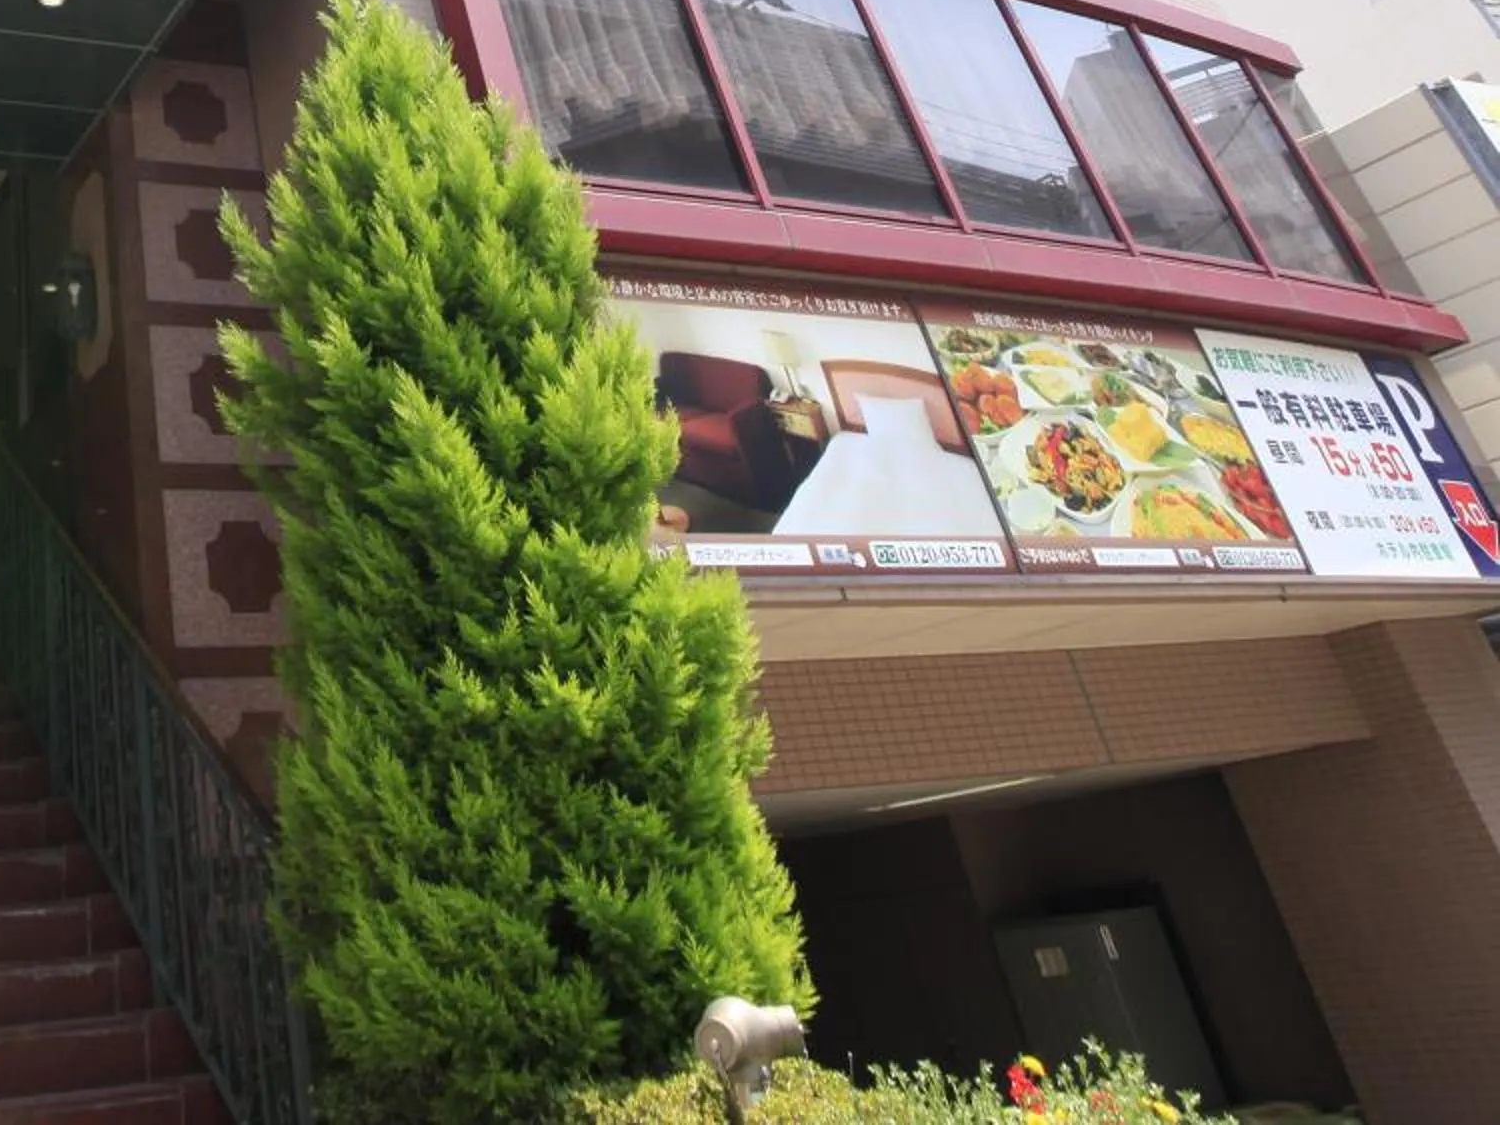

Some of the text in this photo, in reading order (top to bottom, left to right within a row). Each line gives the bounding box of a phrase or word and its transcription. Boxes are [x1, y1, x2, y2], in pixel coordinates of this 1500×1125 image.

[1236, 388, 1397, 437] 一般有料駐車場
[1375, 373, 1444, 464] P
